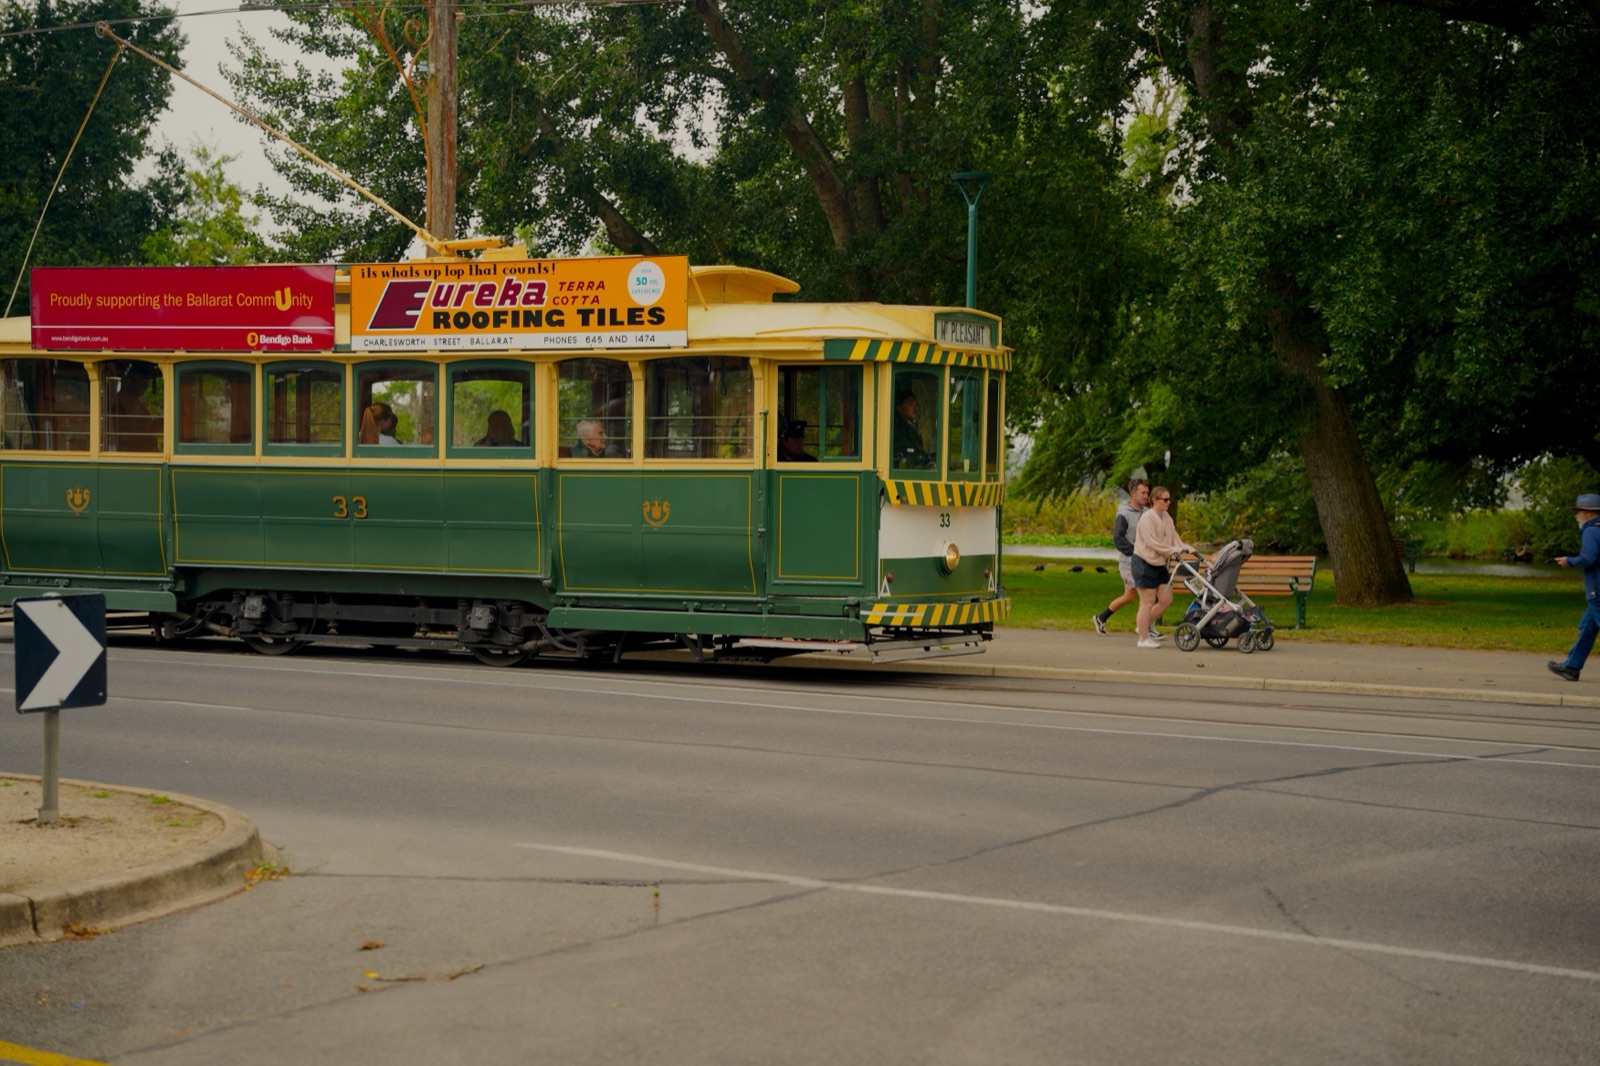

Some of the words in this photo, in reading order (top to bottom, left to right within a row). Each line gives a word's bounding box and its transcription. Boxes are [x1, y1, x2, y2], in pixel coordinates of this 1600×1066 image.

[424, 269, 442, 280] up
[558, 280, 606, 292] TERRA
[636, 277, 647, 286] 50
[50, 293, 93, 310] Proudly
[96, 293, 160, 310] supporting
[163, 293, 183, 307] the
[186, 293, 233, 307] Ballarat
[236, 287, 313, 312] CommUnity
[367, 277, 548, 330] Eureka
[552, 295, 600, 306] COTTA
[433, 310, 565, 329] ROOFING
[577, 307, 665, 327] TILES
[51, 335, 109, 343] www.bendigobank.com.au
[543, 336, 578, 345] PHONES
[585, 335, 603, 343] 645
[608, 335, 628, 343] AND
[635, 334, 656, 342] 1474
[951, 322, 985, 345] PLEASANT
[260, 334, 291, 346] Bendigo
[292, 334, 313, 344] Bank
[363, 338, 426, 347] CHARLESWORTH
[433, 337, 461, 346] STREET
[469, 336, 514, 346] BALLARAT
[332, 495, 369, 519] 33
[940, 512, 951, 528] 33
